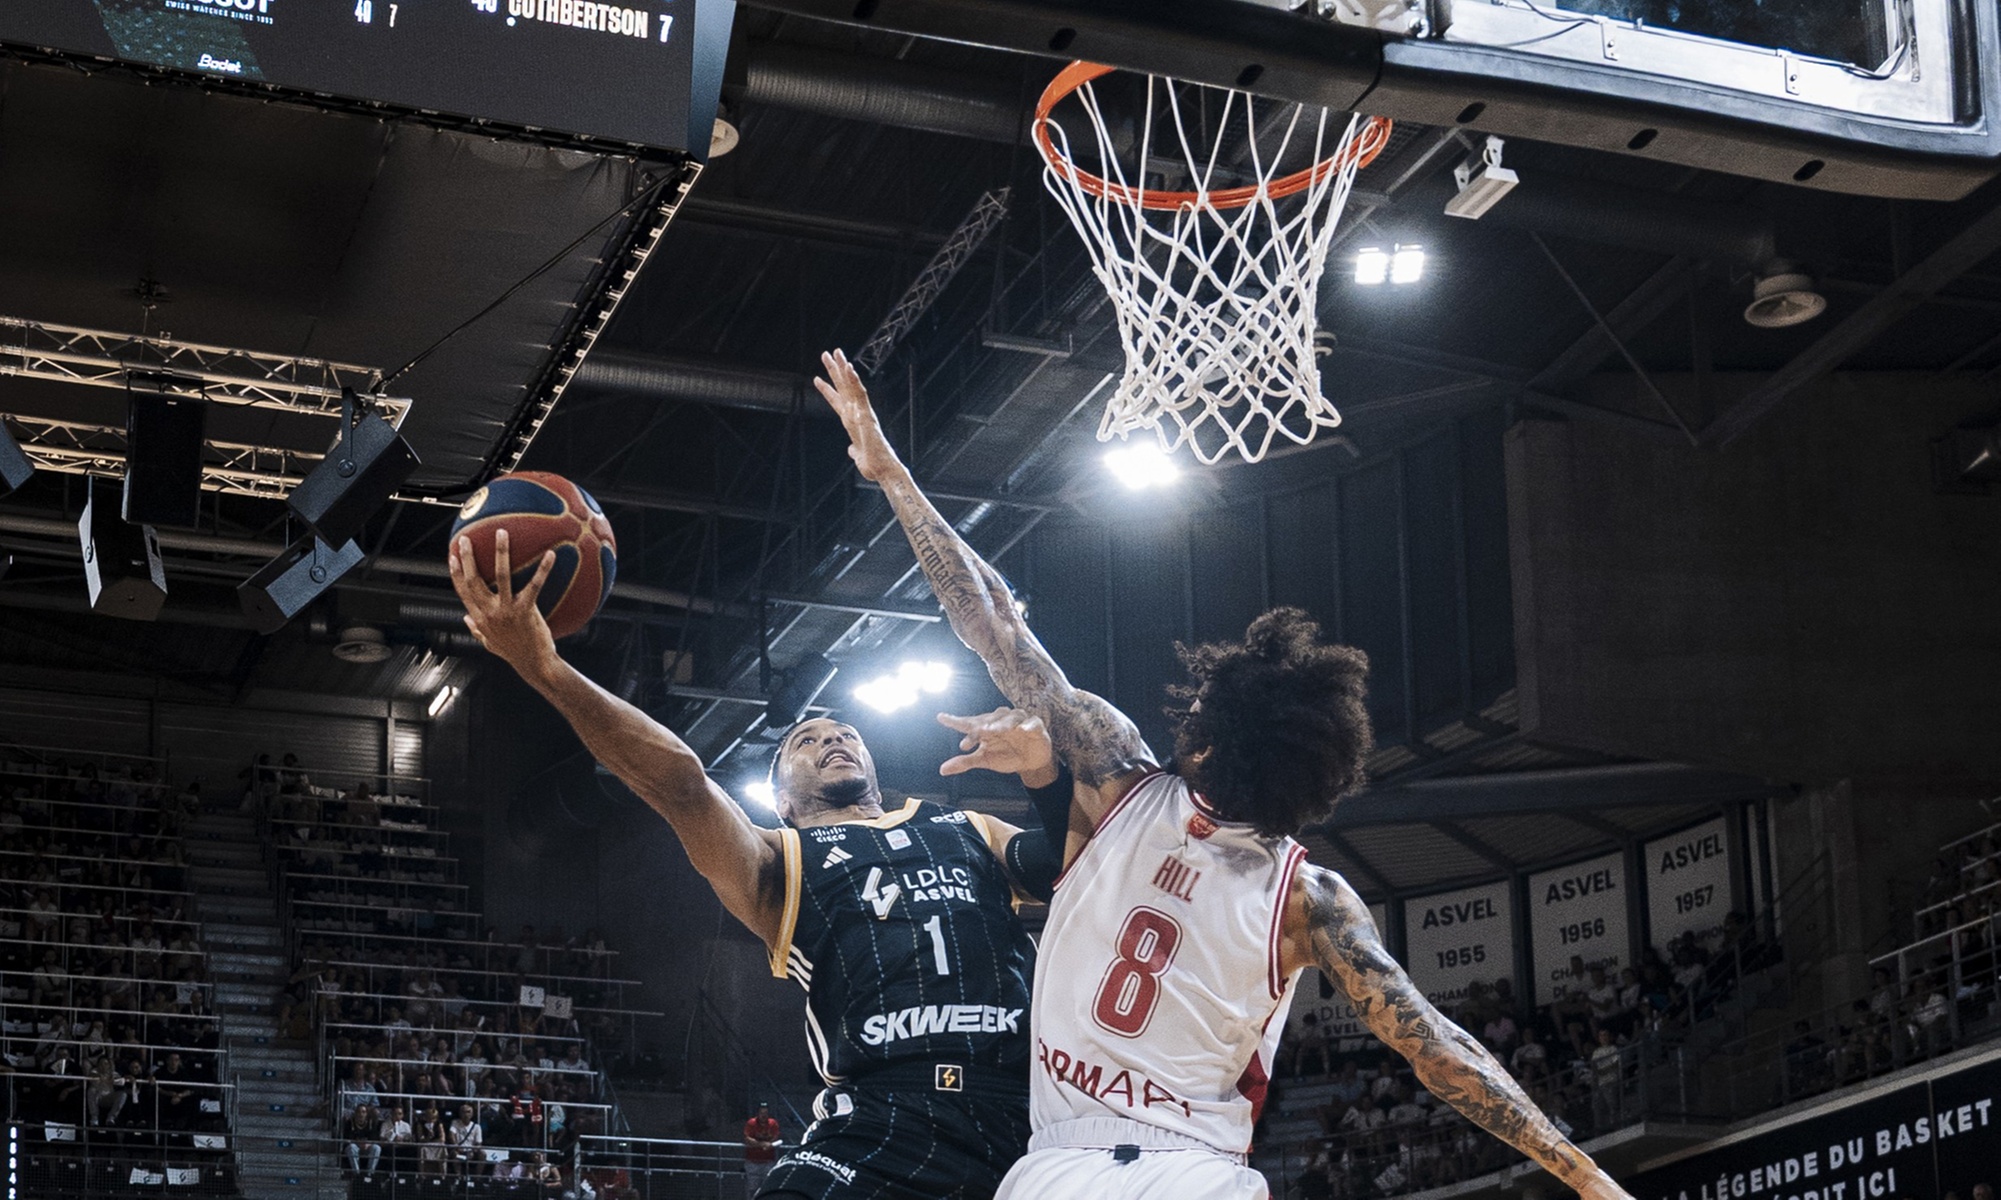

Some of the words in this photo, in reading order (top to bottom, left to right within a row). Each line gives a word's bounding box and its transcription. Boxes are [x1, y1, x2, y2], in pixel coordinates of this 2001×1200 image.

[192, 4, 228, 17] WATCHES
[230, 10, 254, 21] SINCE
[389, 3, 398, 28] 7
[507, 0, 649, 39] CUTHBERTSON
[659, 14, 674, 43] 7
[197, 53, 241, 73] Bodet
[1660, 833, 1724, 874] ASVEL
[903, 865, 968, 890] LDLC
[1151, 854, 1201, 904] HILL
[1545, 869, 1616, 905] ASVEL
[913, 886, 976, 903] ASVEL
[1675, 884, 1714, 914] 1957
[1422, 898, 1497, 930] ASVEL
[923, 915, 950, 976] 1
[1560, 918, 1605, 945] 1956
[1091, 905, 1183, 1039] 8
[1436, 944, 1486, 969] 1955
[860, 1005, 1023, 1046] SKWEEK
[1321, 1005, 1358, 1020] DLC
[1324, 1021, 1360, 1035] SVEL
[1701, 1151, 1819, 1200] LÉGENDE
[1829, 1136, 1863, 1170] DU
[1876, 1098, 1992, 1157] BASKET
[1858, 1167, 1896, 1200] ICI
